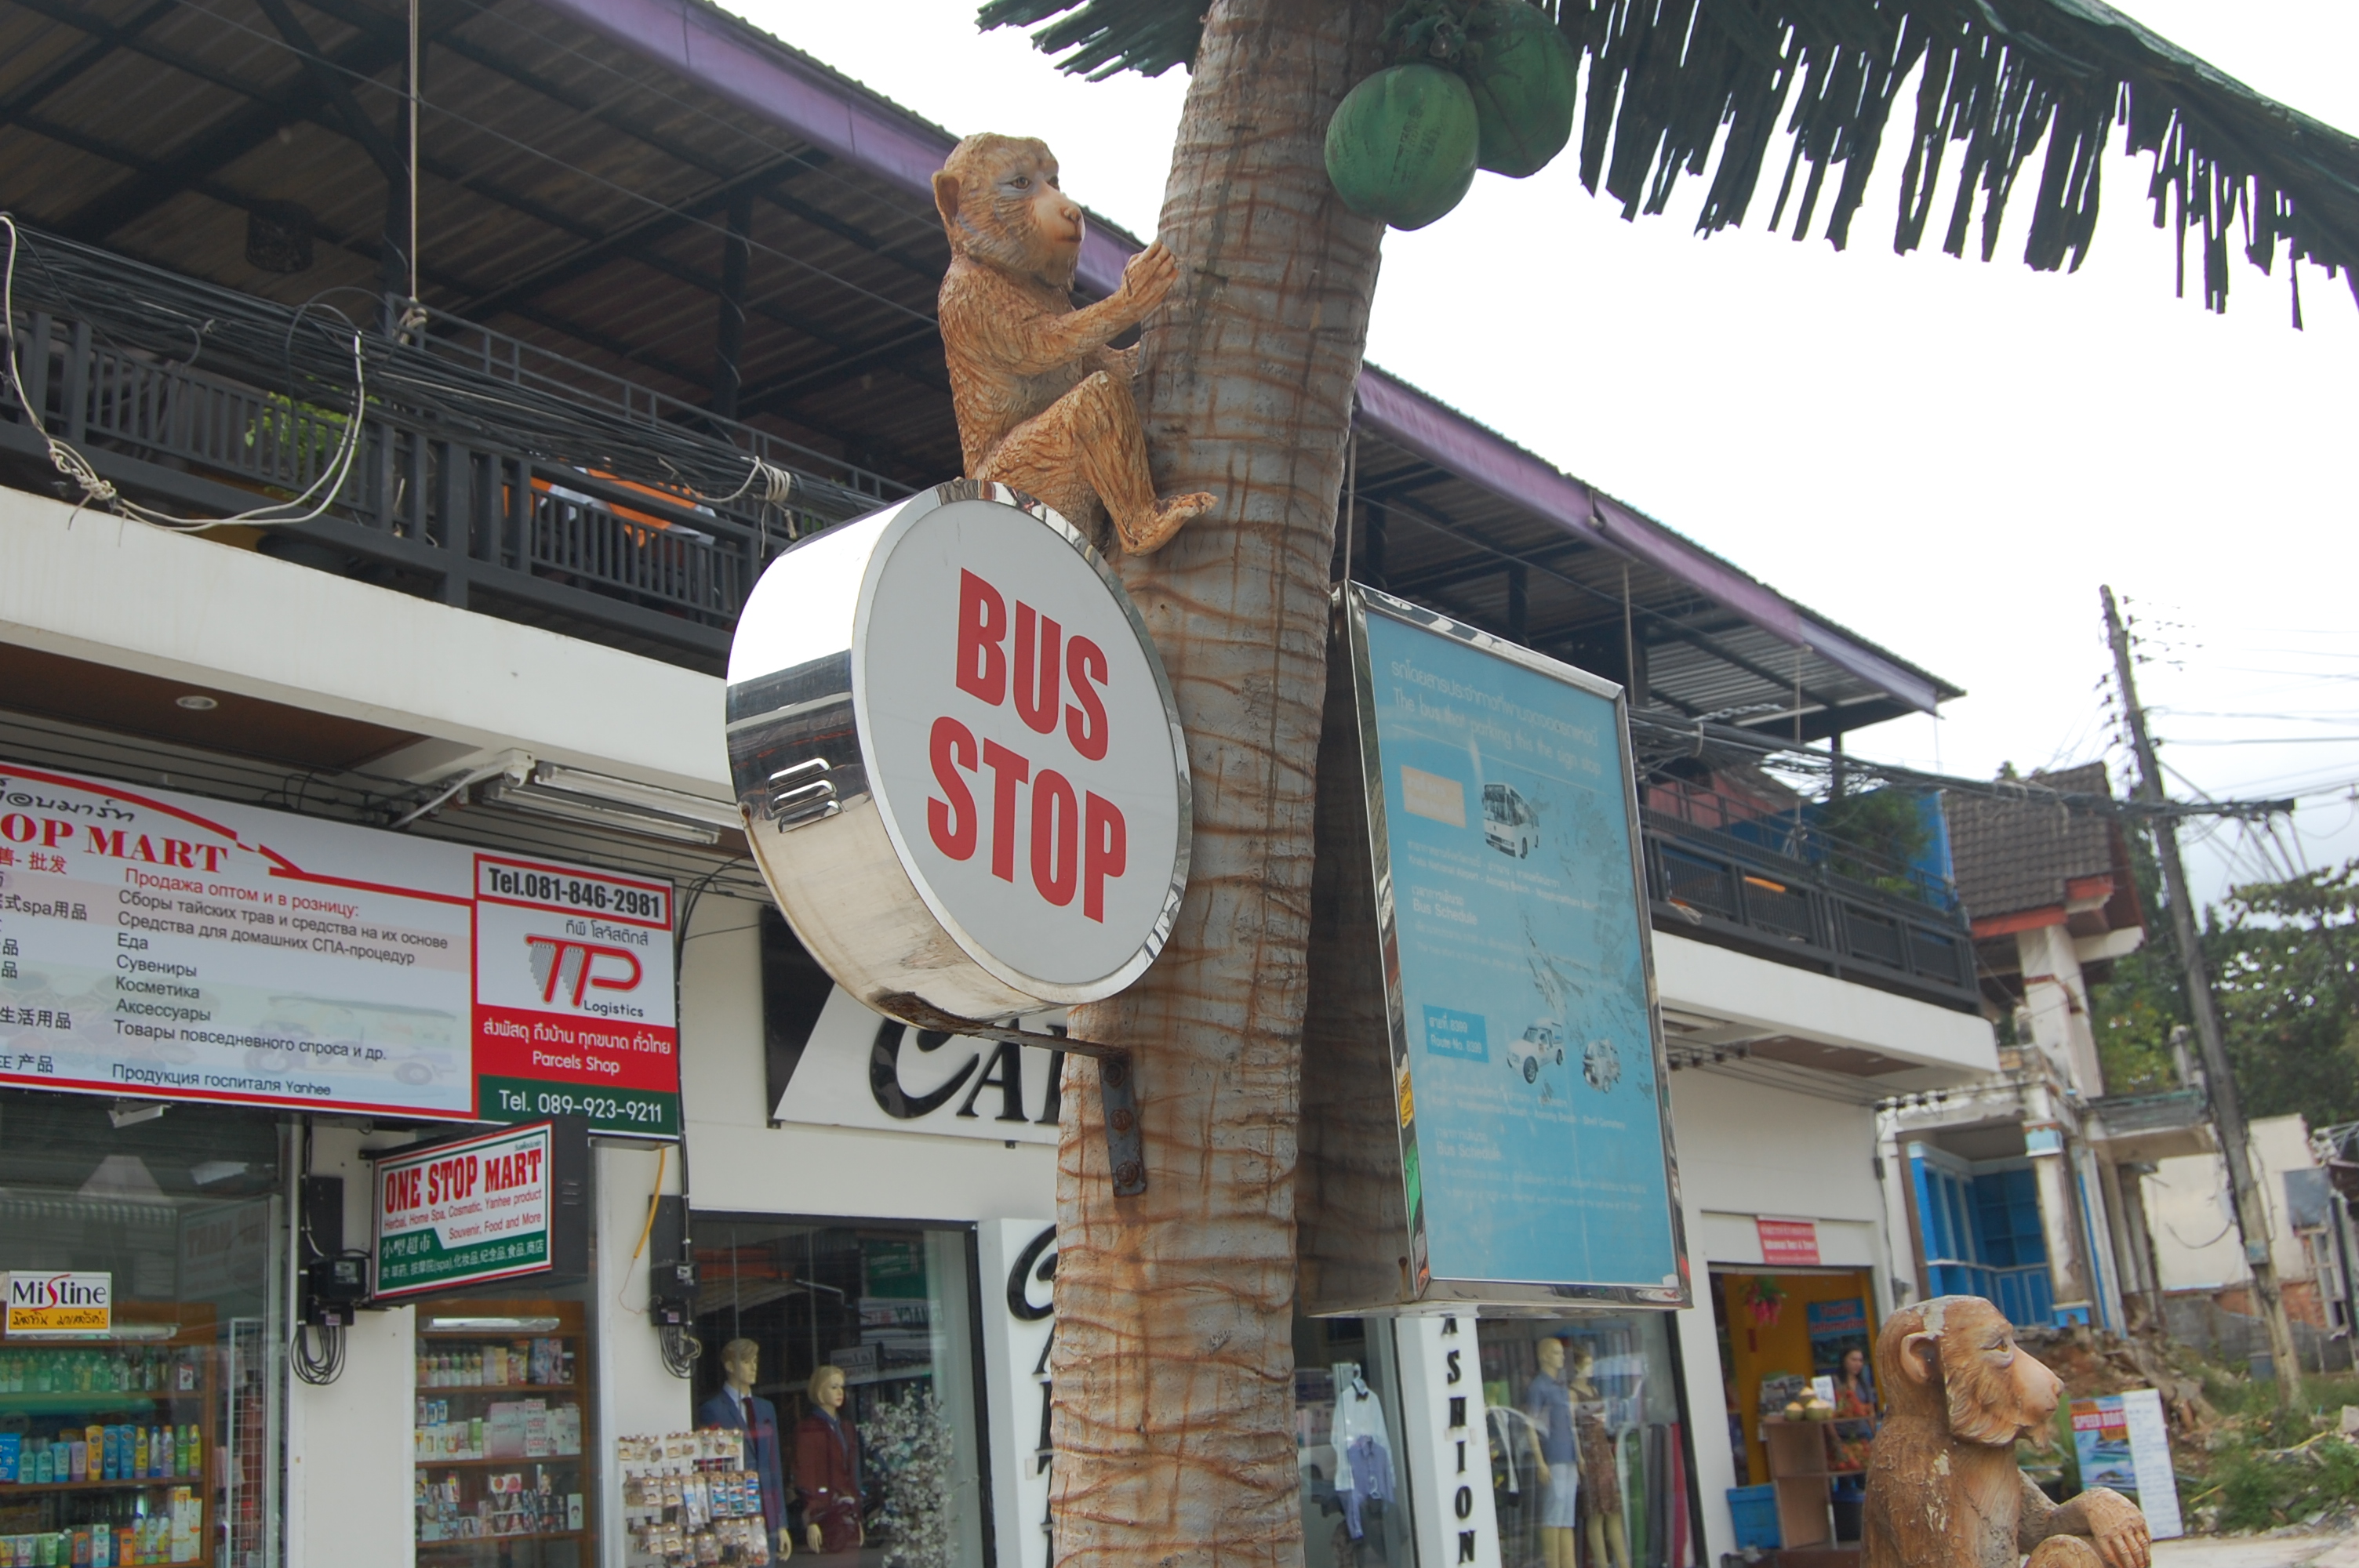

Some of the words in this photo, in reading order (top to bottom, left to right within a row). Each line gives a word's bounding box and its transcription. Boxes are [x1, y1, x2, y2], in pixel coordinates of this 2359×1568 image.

[955, 567, 1108, 761] BUS
[1393, 686, 1415, 712] The
[1419, 693, 1440, 720] bus
[1470, 717, 1511, 750] parking
[927, 715, 1127, 924] STOP
[83, 825, 228, 873] MART
[0, 894, 87, 920] 式spa用品
[125, 867, 203, 894] Продажа
[209, 884, 258, 901] оптом
[264, 892, 273, 904] и
[278, 895, 287, 906] в
[292, 896, 358, 919] розницу:
[488, 867, 660, 918] Tel.081-846-2981
[119, 890, 173, 911] Сборы
[177, 900, 237, 919] тайских
[241, 910, 274, 924] трав
[279, 916, 288, 926] и
[292, 918, 357, 936] средства
[362, 927, 377, 939] на
[382, 930, 398, 941] их
[402, 932, 448, 949] основе
[1413, 898, 1431, 915] Bus
[1435, 903, 1478, 925] Schedule
[118, 911, 194, 935] Средства
[198, 925, 227, 938] для
[231, 930, 308, 949] домашних
[312, 938, 415, 966] СПА-процедур
[118, 933, 148, 949] Еда
[117, 954, 197, 978] Сувениры
[116, 976, 200, 999] Косметика
[116, 998, 211, 1022] Аксессуары
[583, 1000, 644, 1018] Logistics
[114, 1019, 175, 1040] Товары
[180, 1029, 294, 1051] повседневного
[299, 1041, 348, 1056] спроса
[353, 1047, 361, 1057] и
[365, 1048, 387, 1061] др.
[483, 1018, 529, 1044] ส่งพัสดุ
[533, 1022, 574, 1044] ถึงบ้าน
[578, 1031, 628, 1050] ทุกขนาด
[633, 1031, 671, 1055] ทั่วไทย
[1430, 1033, 1451, 1049] Route
[112, 1063, 199, 1085] Продукция
[205, 1074, 281, 1091] госпиталя
[285, 1081, 331, 1094] Yanhee
[533, 1051, 582, 1070] Parcels
[586, 1056, 620, 1076] Shop
[499, 1089, 531, 1112] Tel.
[538, 1093, 662, 1123] 089-923-9211
[384, 1167, 421, 1214] ONE
[427, 1155, 478, 1206] STOP
[485, 1148, 542, 1193] MART
[409, 1214, 429, 1225] Home
[485, 1196, 511, 1209] Yanhee
[514, 1189, 541, 1207] product
[485, 1218, 503, 1232] Food
[506, 1215, 519, 1229] and
[522, 1212, 541, 1225] More
